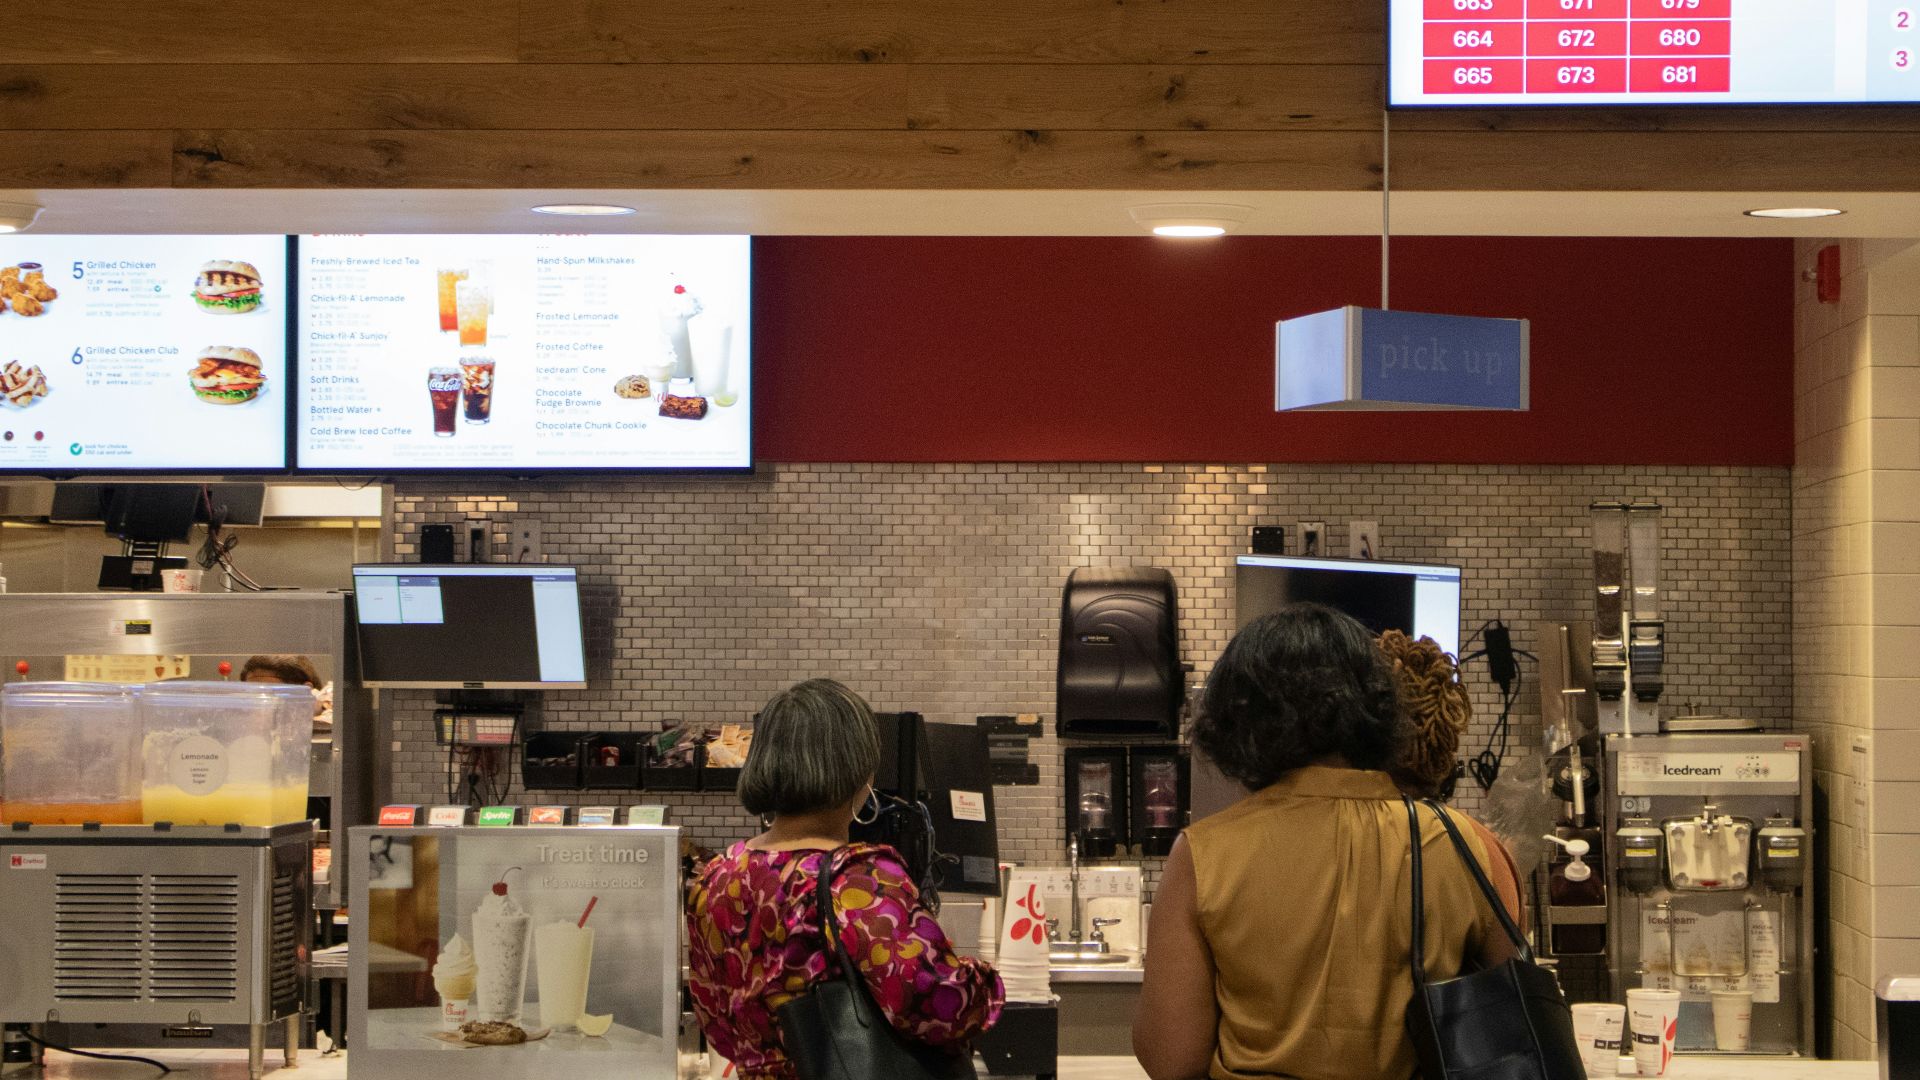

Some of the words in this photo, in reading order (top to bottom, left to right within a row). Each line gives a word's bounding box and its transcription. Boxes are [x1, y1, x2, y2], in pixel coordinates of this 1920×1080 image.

[1897, 12, 1908, 29] 2
[1453, 30, 1493, 48] 664
[1558, 30, 1595, 47] 672
[1659, 28, 1700, 46] 680
[1896, 50, 1908, 67] 3
[1453, 67, 1493, 84] 665
[1558, 66, 1595, 84] 673
[1662, 66, 1697, 83] 681
[73, 262, 84, 279] 5
[87, 261, 118, 270] Grilled
[120, 261, 156, 270] Chicken
[359, 332, 388, 342] Sunjoy
[86, 346, 116, 355] Grilled
[119, 346, 155, 355] Chicken
[158, 346, 179, 355] Club
[572, 342, 604, 350] Coffee
[72, 347, 83, 364] 6
[1380, 337, 1448, 378] pick
[1464, 350, 1502, 384] up
[536, 399, 563, 408] Fudge
[1663, 765, 1721, 776] Icedream
[483, 812, 511, 820] Sprite
[536, 844, 593, 863] Treat
[600, 843, 649, 863] time
[561, 878, 598, 888] sweet
[1648, 916, 1695, 925] Icedeam
